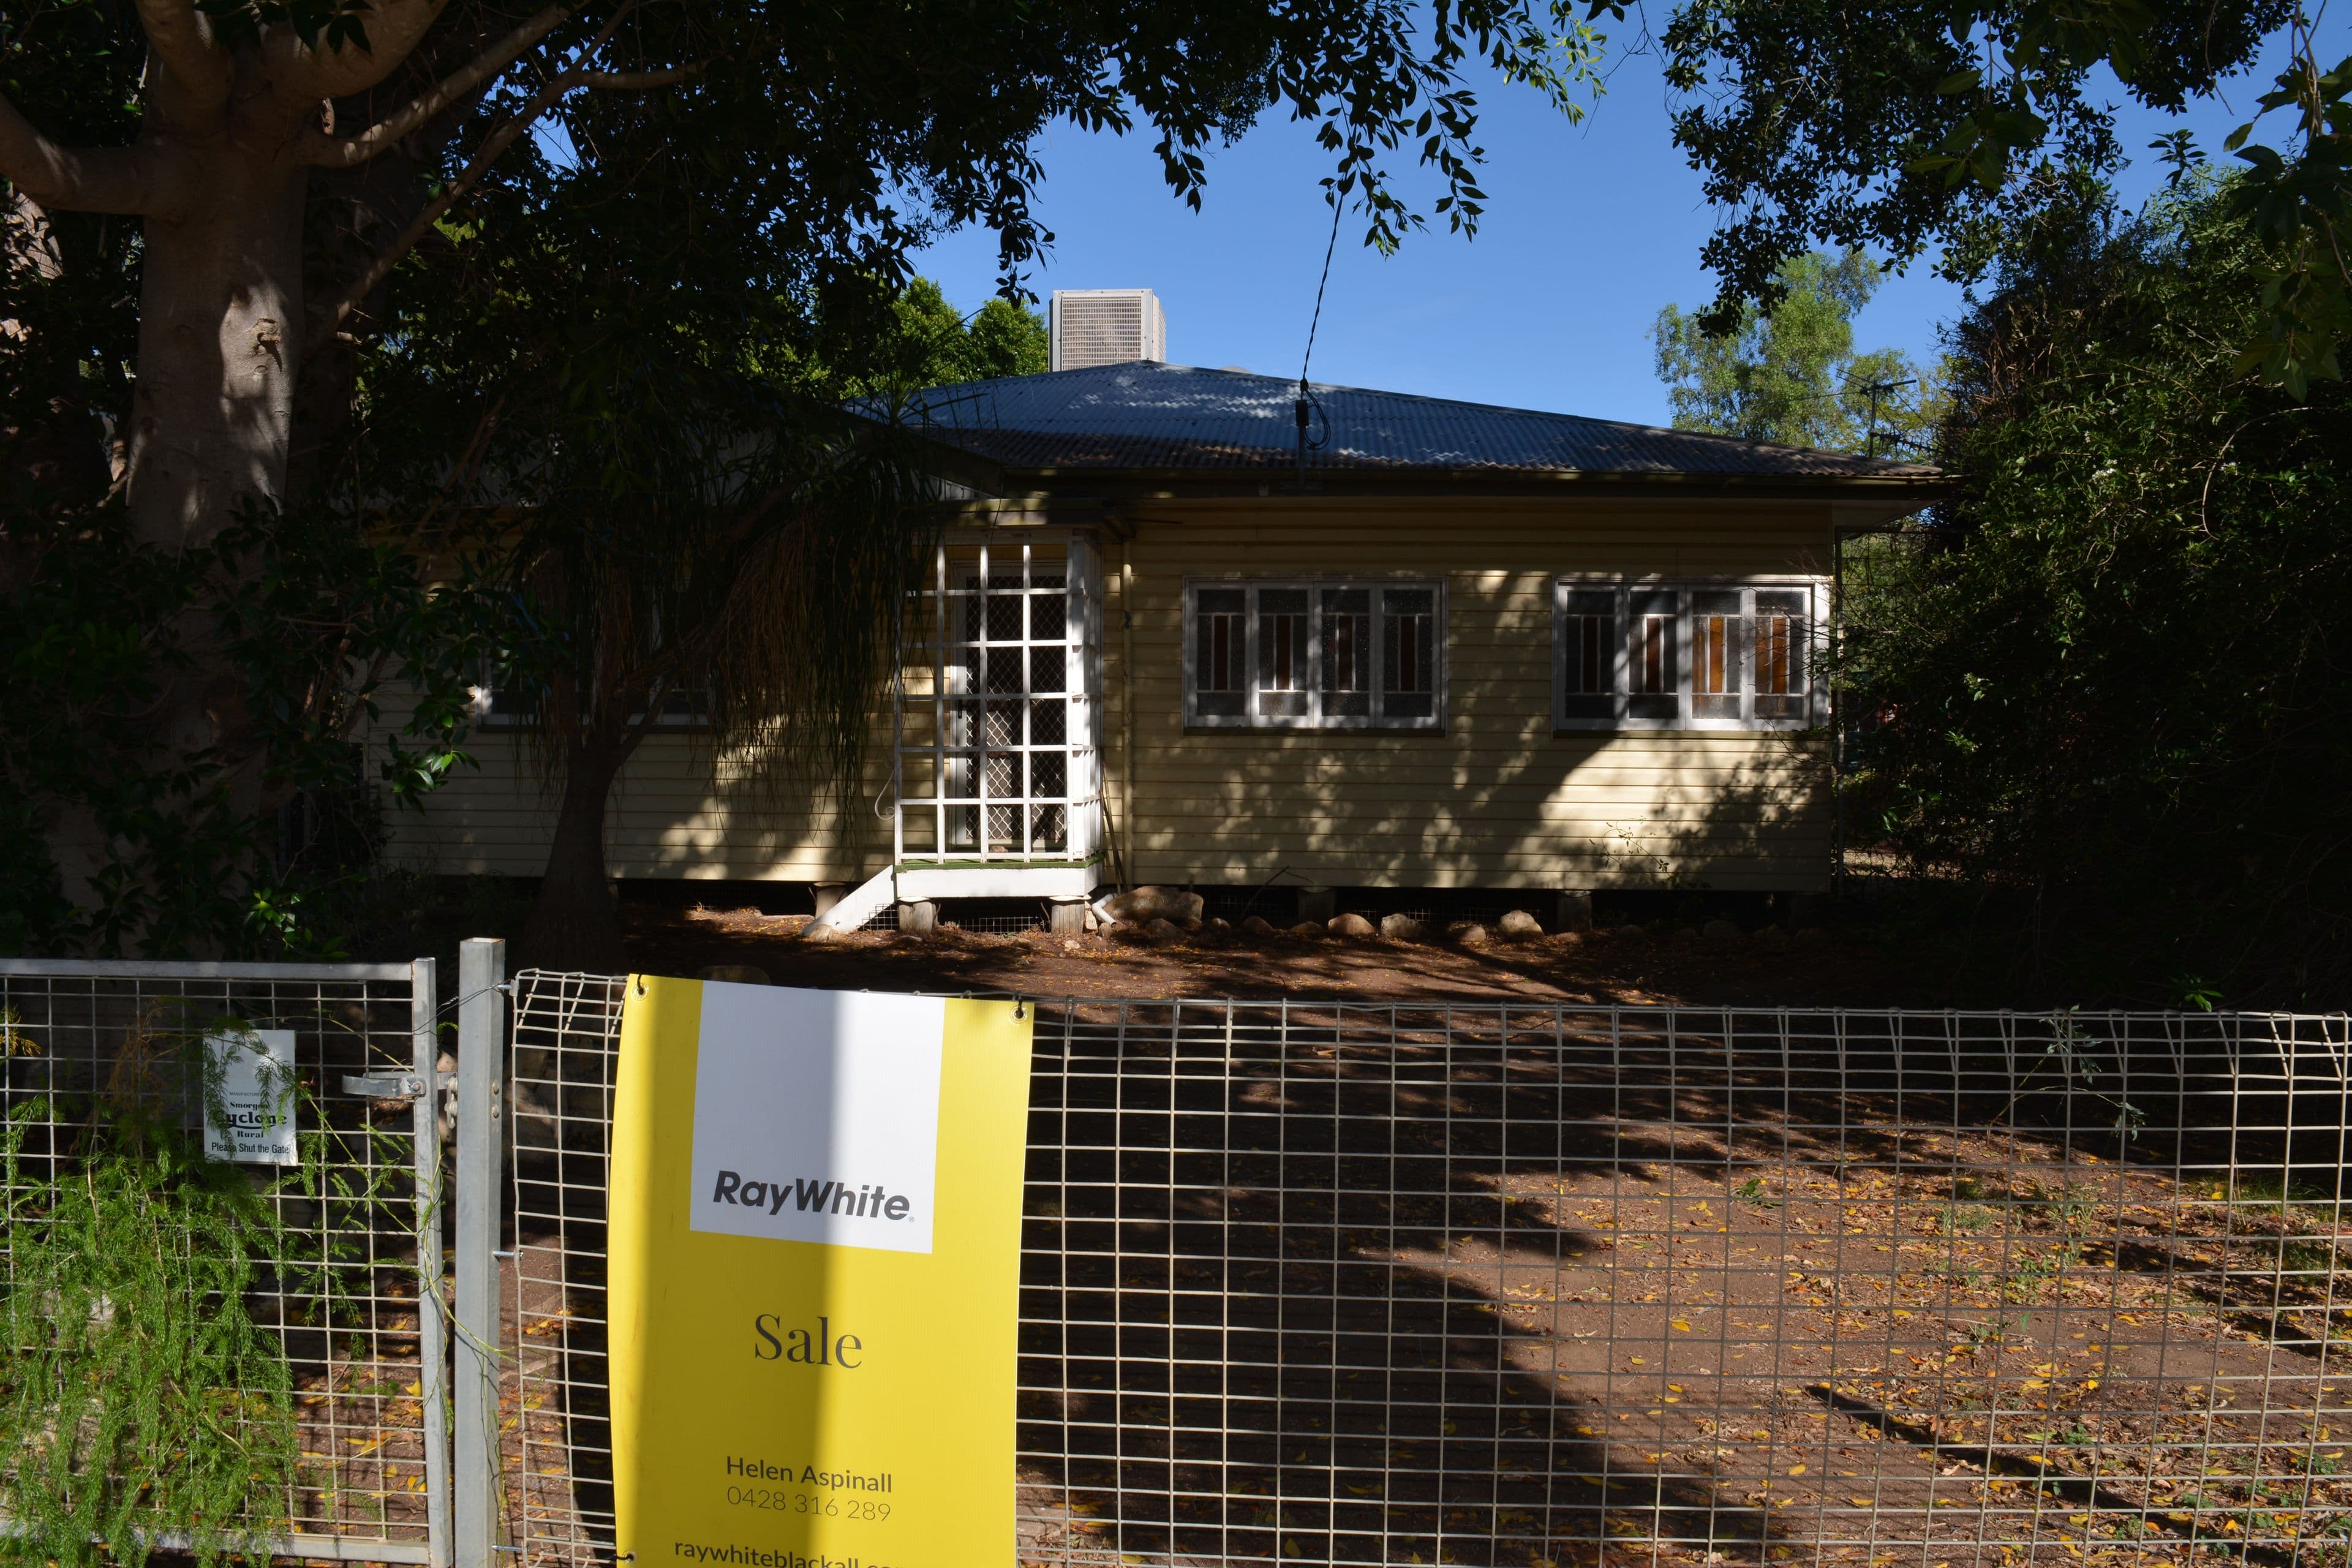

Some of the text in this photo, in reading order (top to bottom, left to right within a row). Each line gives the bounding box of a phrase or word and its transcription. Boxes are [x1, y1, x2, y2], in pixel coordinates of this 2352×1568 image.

[230, 1101, 268, 1110] Smorg
[219, 1111, 287, 1129] yclone
[211, 1142, 289, 1154] Plea Shut the Gate
[755, 1314, 862, 1368] Sale
[727, 1456, 891, 1493] Helen Aspinall
[727, 1486, 891, 1521] 0428 316 289
